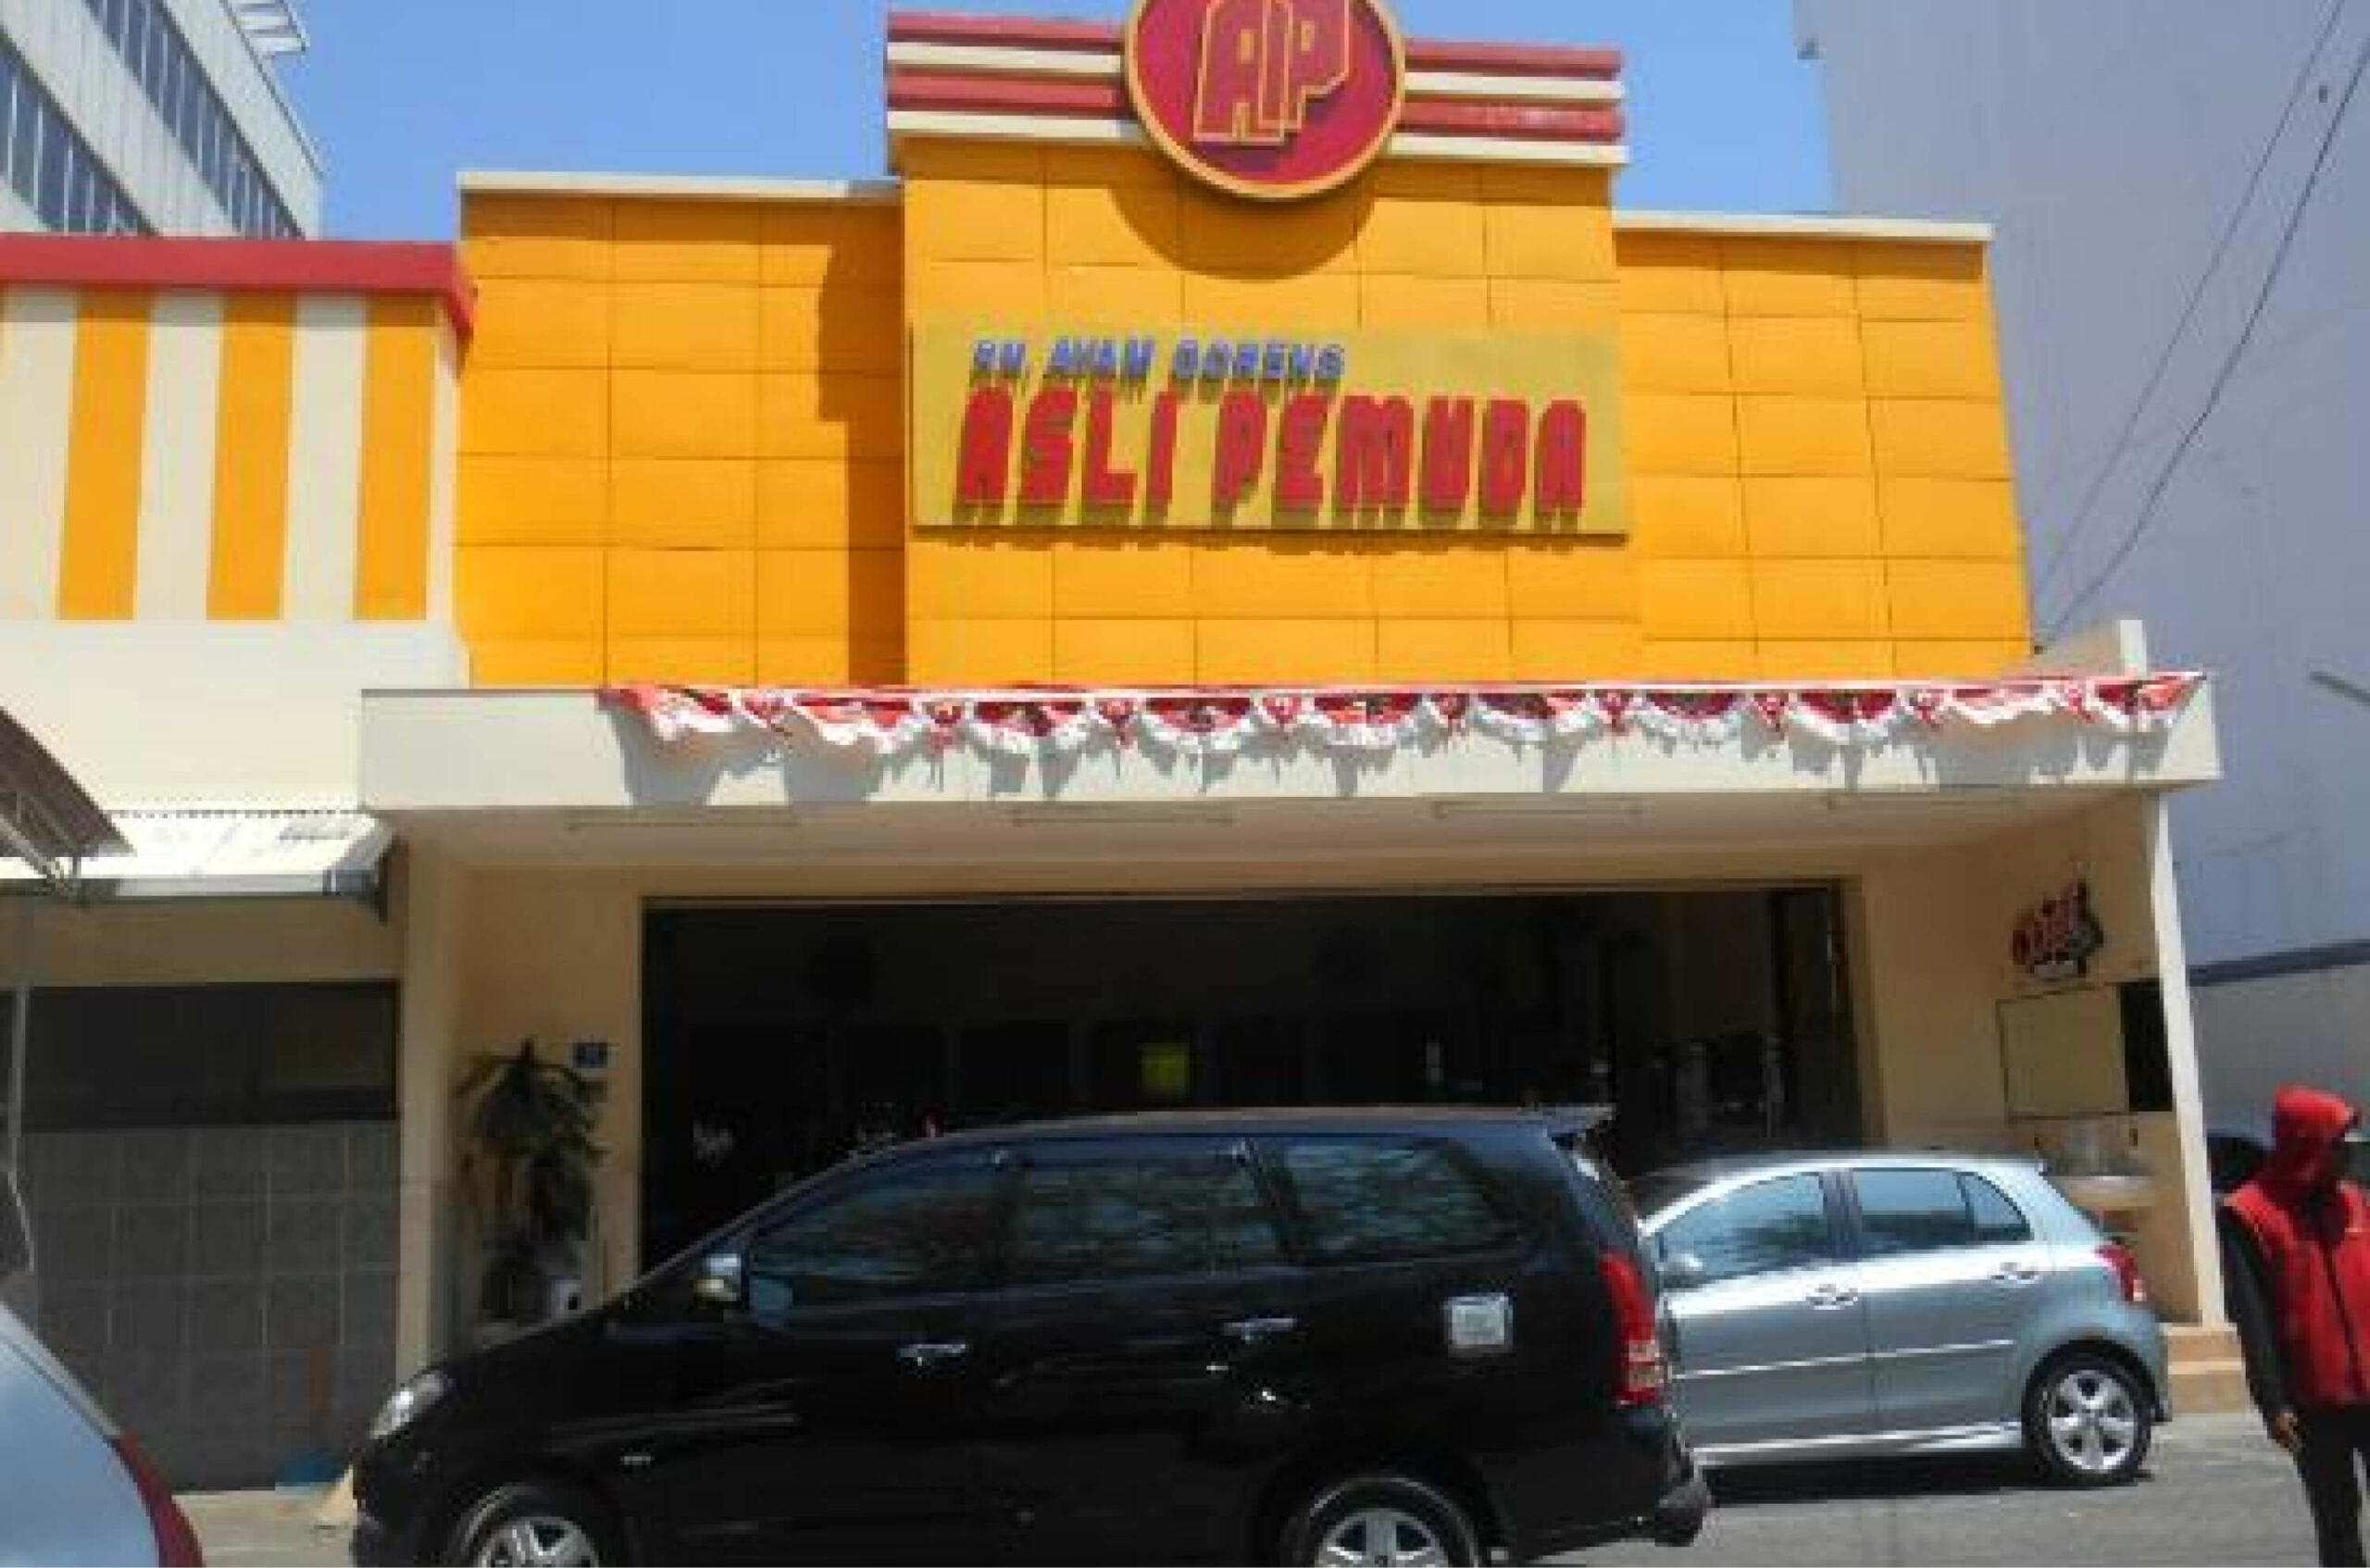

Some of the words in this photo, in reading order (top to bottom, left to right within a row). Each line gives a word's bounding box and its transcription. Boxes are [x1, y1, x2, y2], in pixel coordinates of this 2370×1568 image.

[1043, 335, 1156, 378] AYAM
[957, 384, 1179, 504] ASLI
[1213, 389, 1588, 516] PEMUDA
